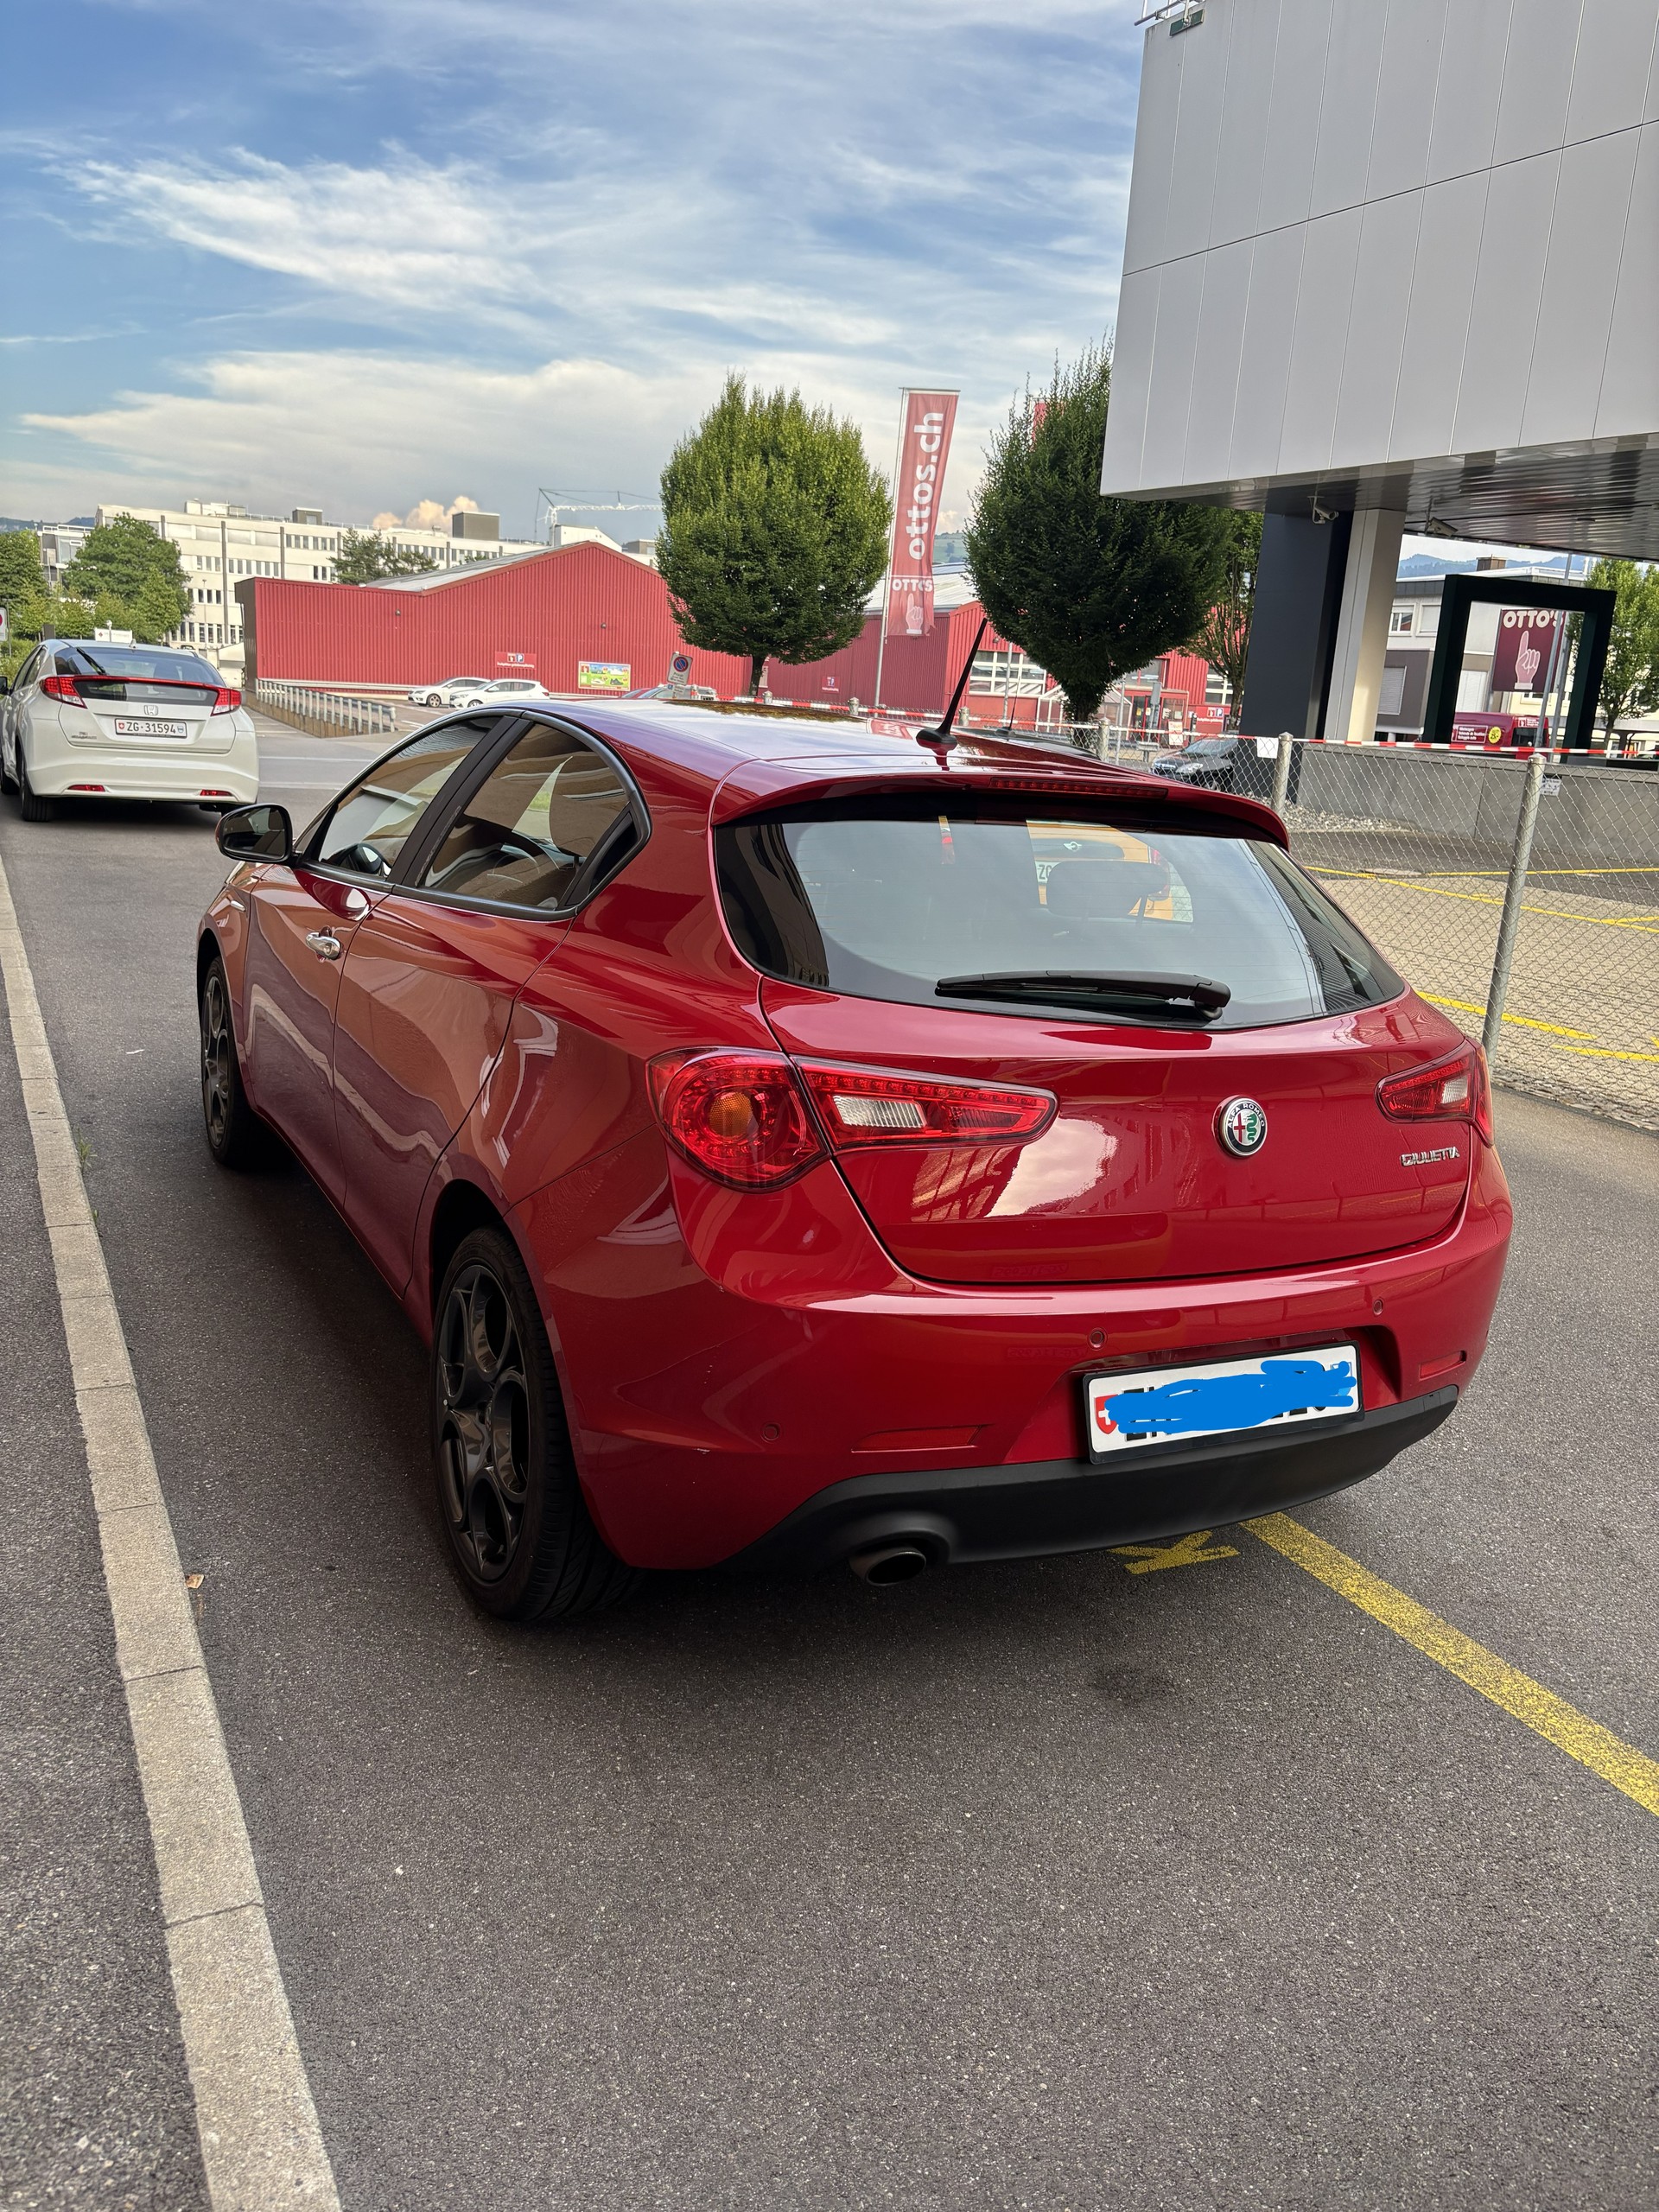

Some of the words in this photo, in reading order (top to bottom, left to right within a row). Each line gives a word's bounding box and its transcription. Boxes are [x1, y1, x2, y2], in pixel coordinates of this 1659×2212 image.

[906, 412, 944, 560] ottos.ch
[1228, 1107, 1240, 1128] ALFA
[1243, 1103, 1265, 1127] ROMEO
[1401, 1146, 1460, 1166] GIULIETTA
